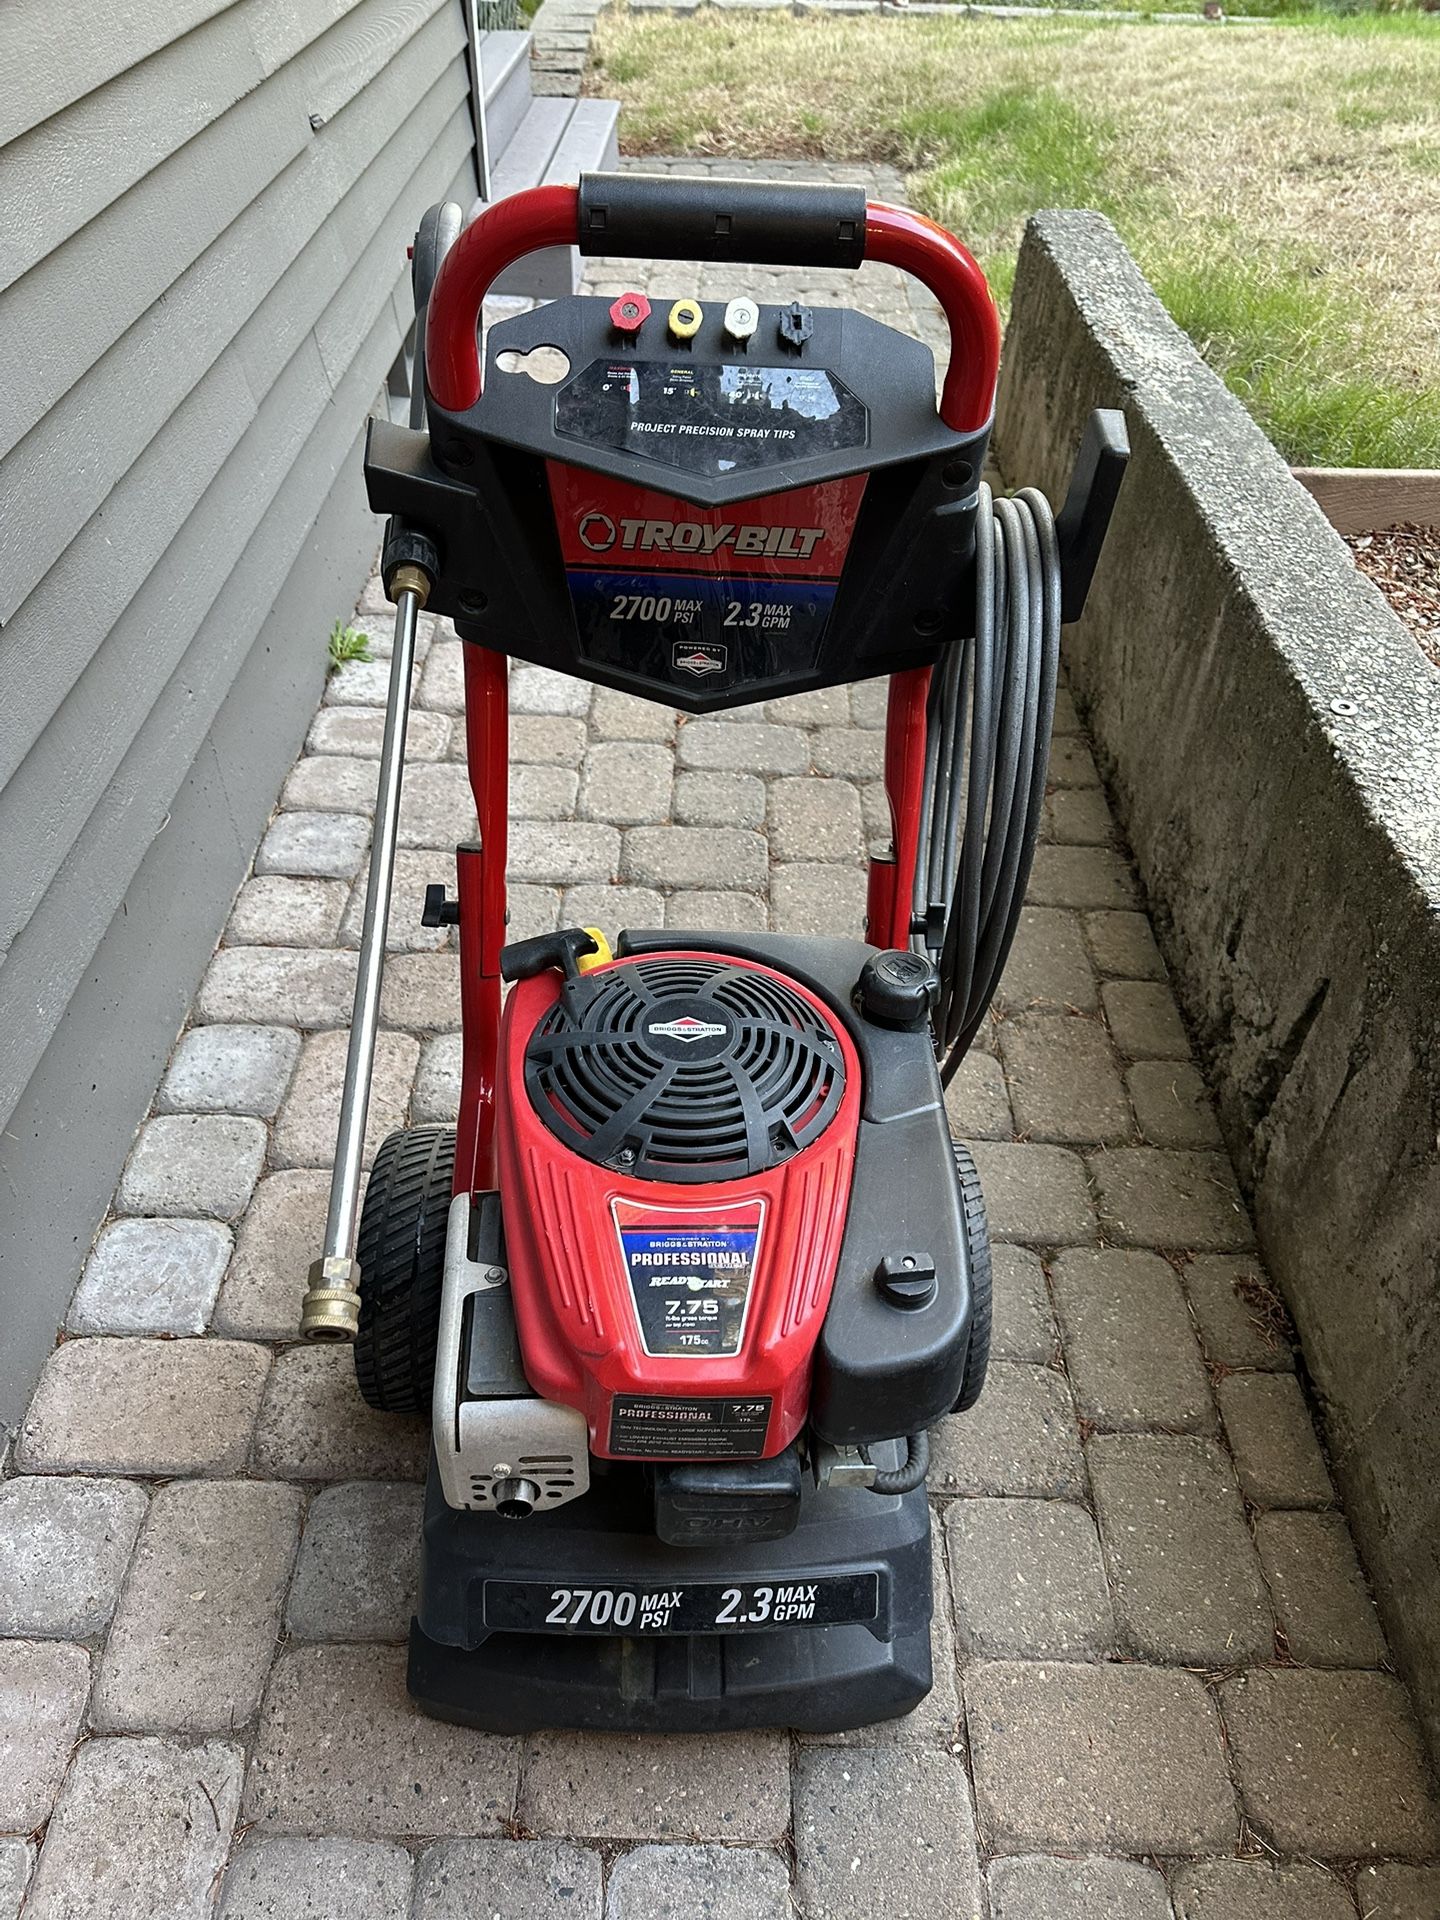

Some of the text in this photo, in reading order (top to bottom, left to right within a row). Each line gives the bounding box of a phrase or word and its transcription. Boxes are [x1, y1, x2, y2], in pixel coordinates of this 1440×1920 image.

[630, 421, 796, 439] PROJECT PRECISION SPRAY TIPS
[620, 518, 825, 559] TROY-BILT
[609, 595, 703, 621] 2700 MAX
[723, 602, 793, 627] 2.3 MAX
[673, 612, 694, 624] PSI
[761, 617, 790, 629] GPM
[631, 1252, 750, 1266] PROFESSIONAL
[649, 1276, 730, 1289] READTART
[665, 1300, 719, 1314] 7.75
[619, 1408, 713, 1420] PROFESSIONAL
[545, 1589, 683, 1627] 2700 MAX
[714, 1584, 818, 1624] 2.3 MAX
[772, 1602, 816, 1622] GPM
[639, 1610, 670, 1629] PSI
